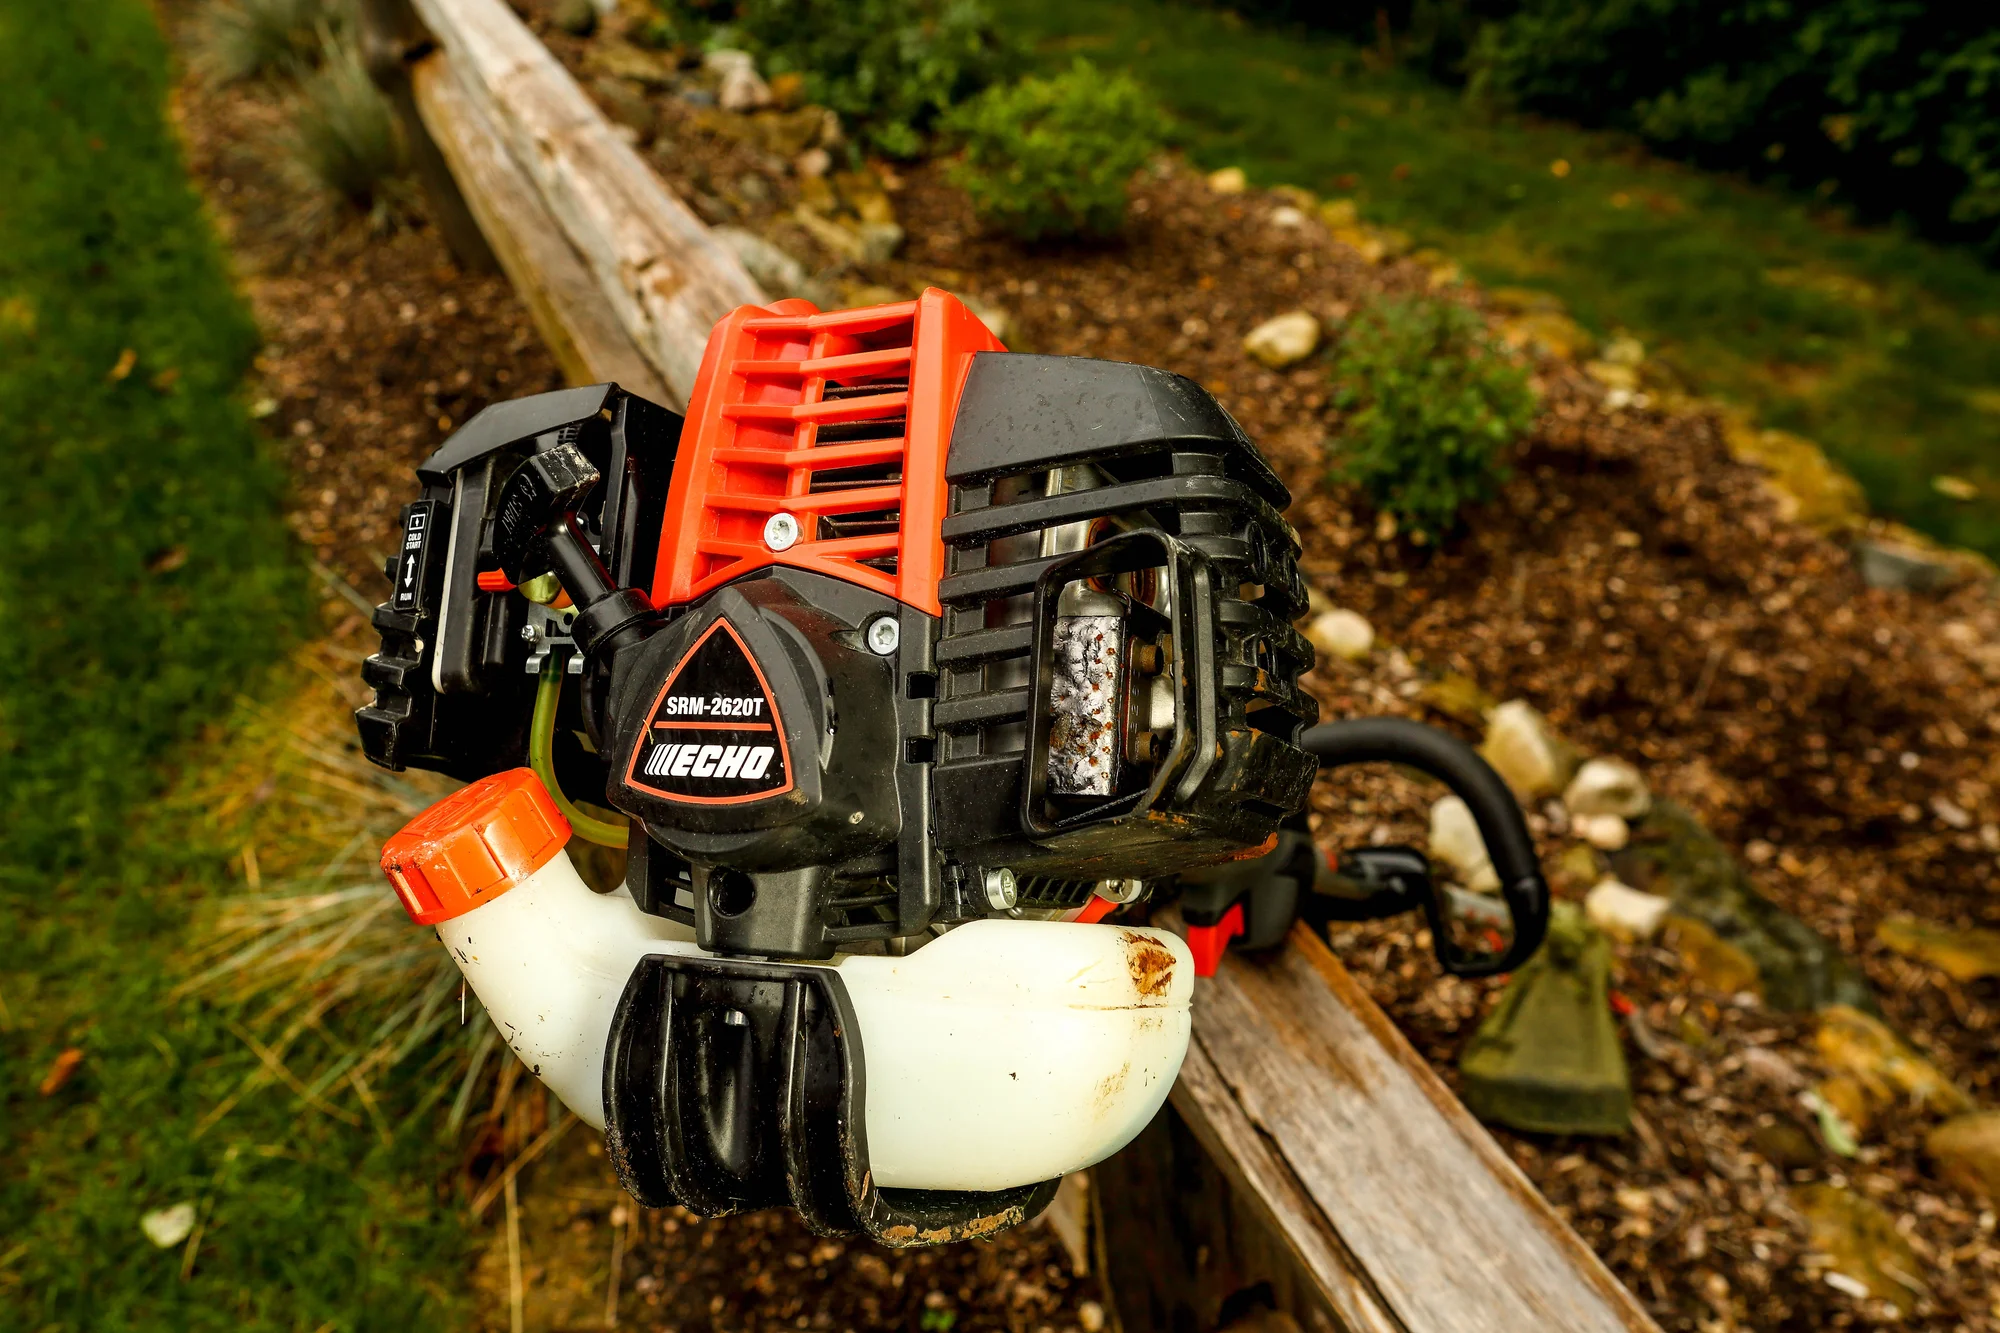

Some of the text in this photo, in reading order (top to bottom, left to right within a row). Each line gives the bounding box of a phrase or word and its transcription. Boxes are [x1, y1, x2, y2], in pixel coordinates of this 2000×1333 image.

[408, 533, 422, 541] COLD
[406, 541, 421, 550] START
[400, 593, 412, 601] RUN
[666, 696, 764, 717] SRM-2620T
[668, 744, 775, 780] ECHO
